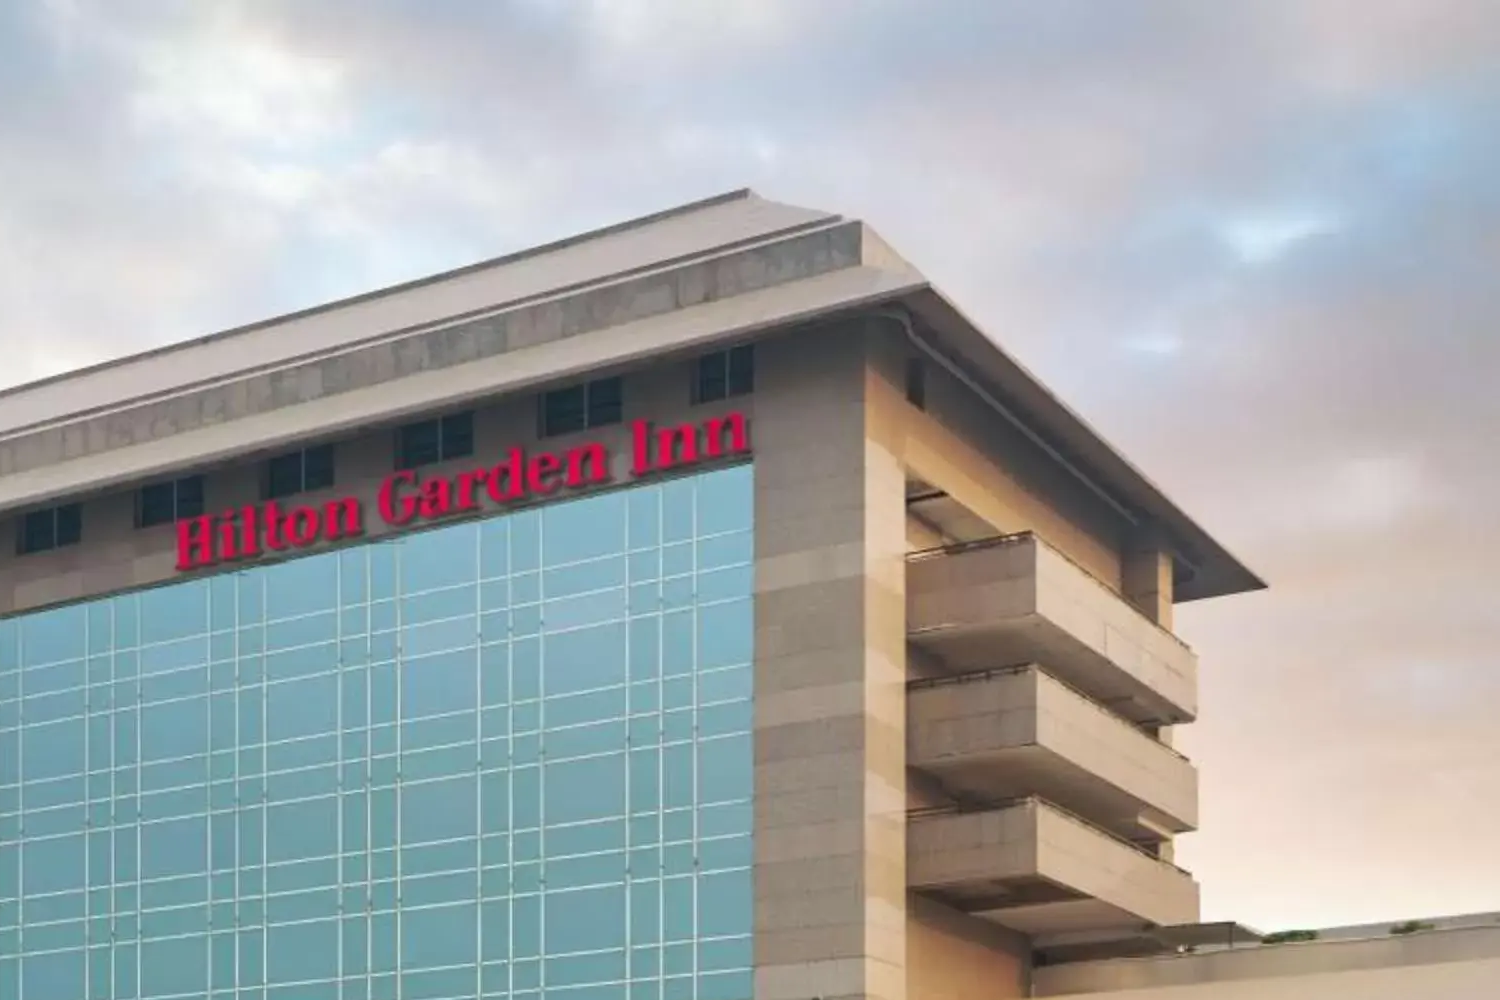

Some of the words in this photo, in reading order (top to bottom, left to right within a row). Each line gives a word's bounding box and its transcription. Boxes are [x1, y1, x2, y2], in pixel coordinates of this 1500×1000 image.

[175, 496, 361, 571] Hilton
[378, 441, 610, 526] Garden
[630, 410, 751, 476] Inn
